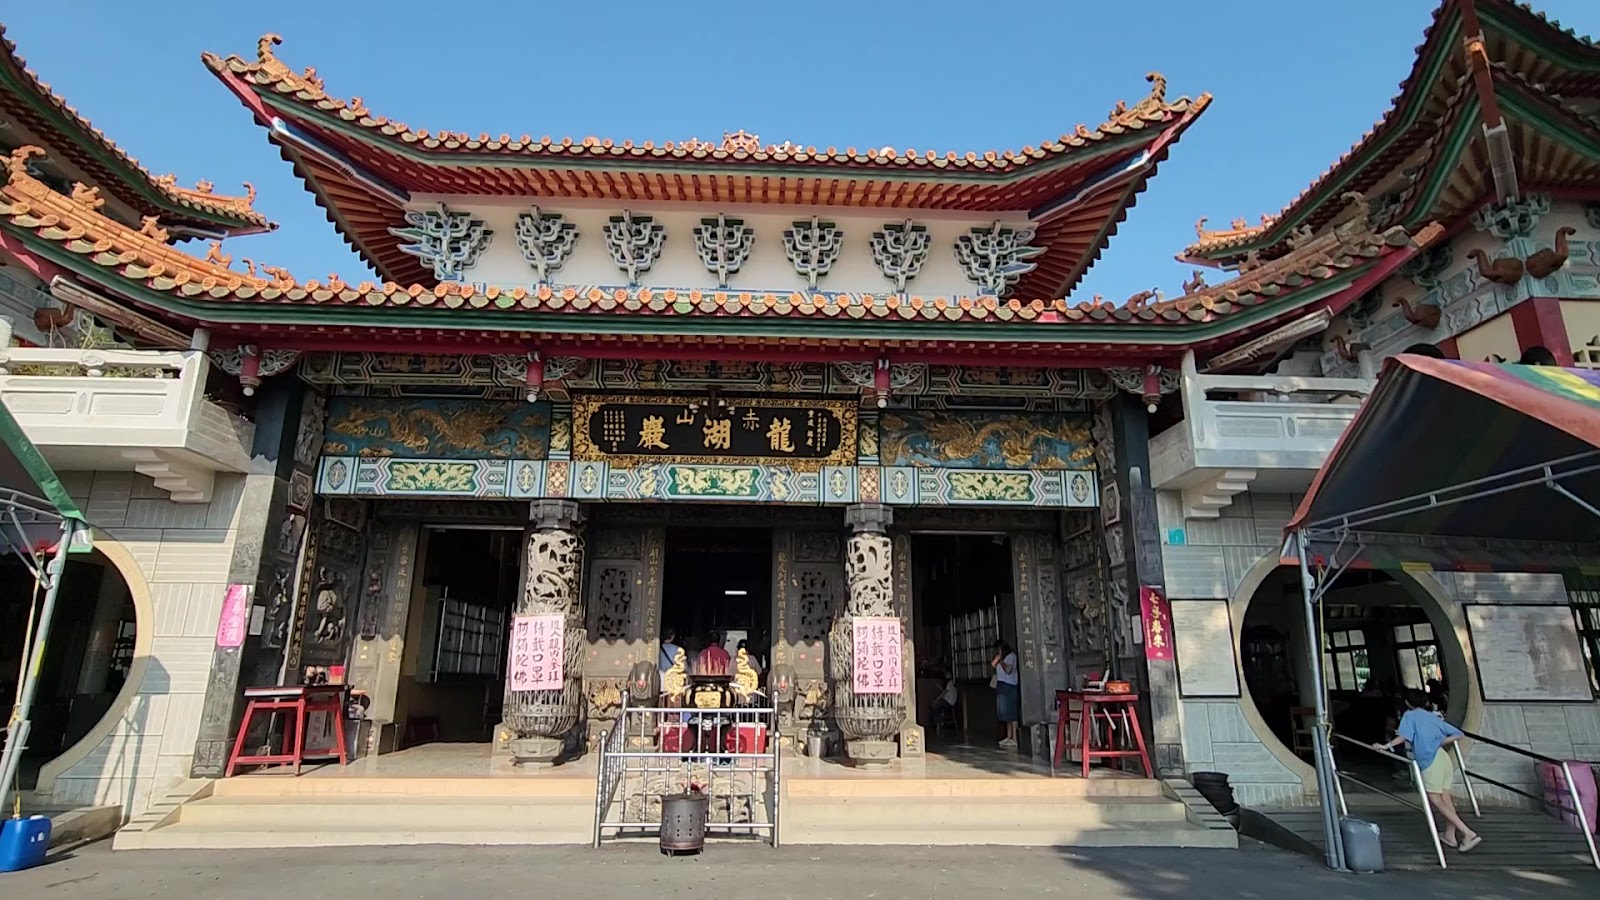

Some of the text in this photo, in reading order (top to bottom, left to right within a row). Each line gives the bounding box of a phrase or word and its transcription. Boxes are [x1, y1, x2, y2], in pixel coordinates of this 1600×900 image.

[531, 620, 544, 684] 請戴口罩
[856, 625, 870, 689] 阿彌陀佛
[871, 625, 884, 689] 請戴口罩
